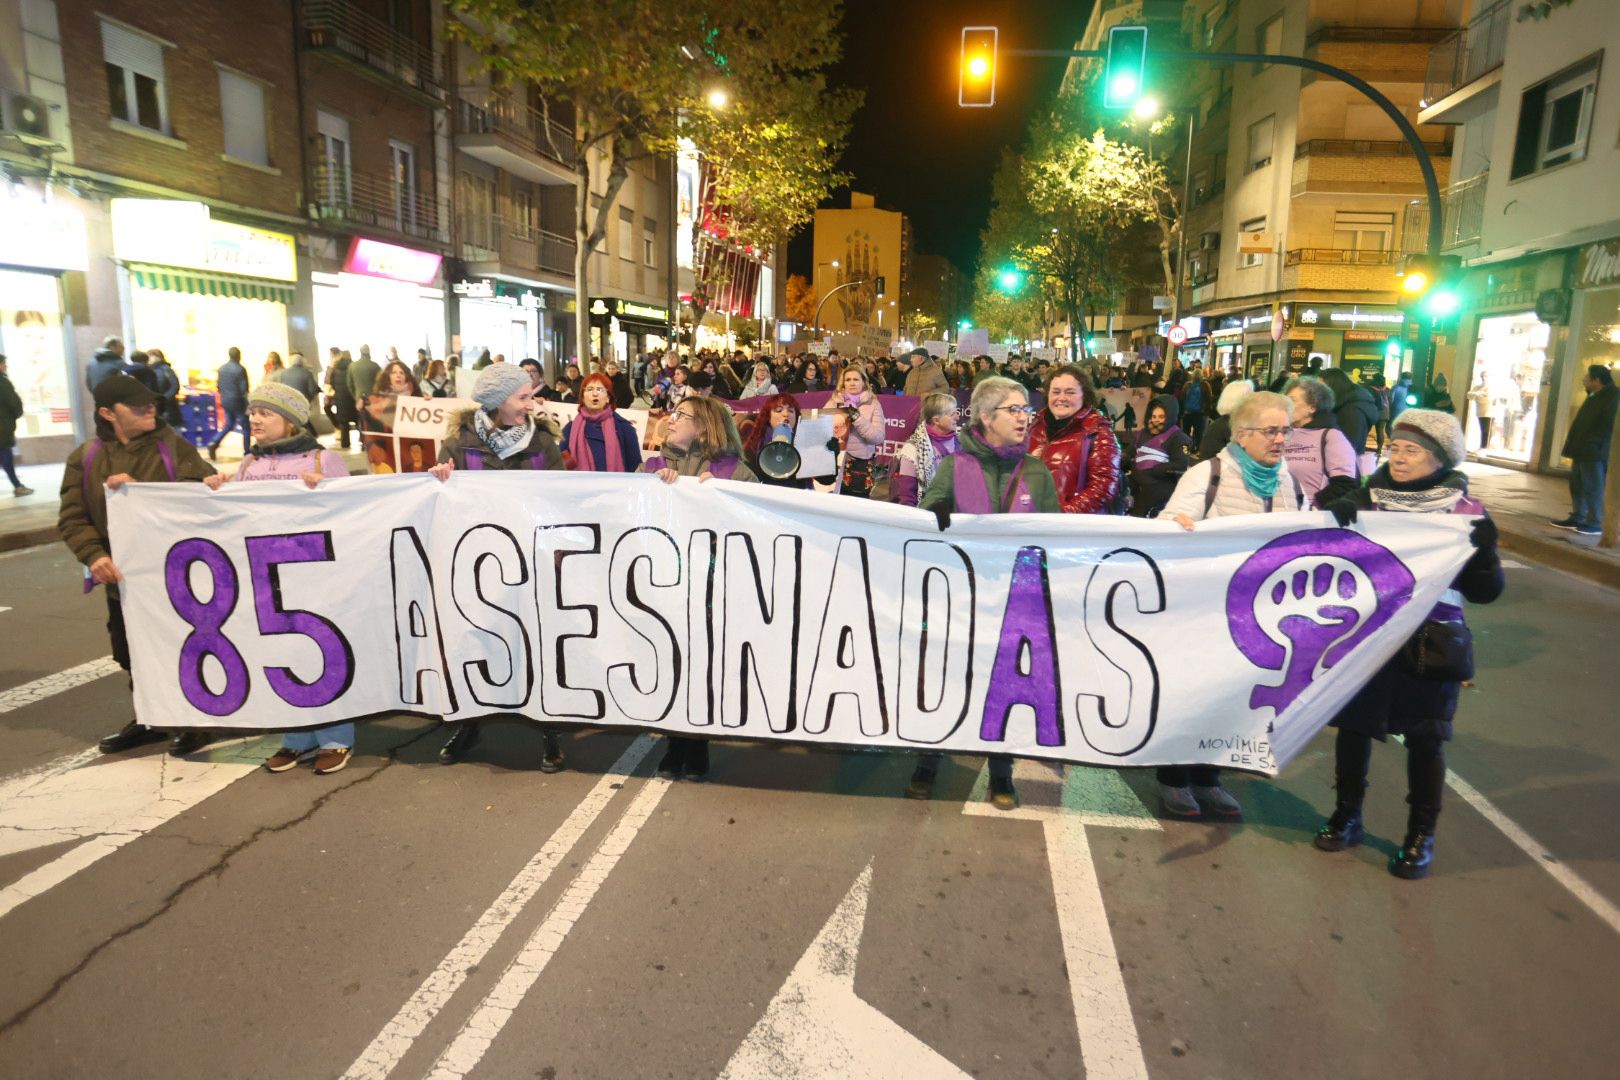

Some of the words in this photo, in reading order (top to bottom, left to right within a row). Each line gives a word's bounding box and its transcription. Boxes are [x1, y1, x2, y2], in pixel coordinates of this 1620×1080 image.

[400, 406, 444, 424] NOS
[164, 529, 356, 717] 85
[389, 522, 1167, 757] ASESINADAS
[1231, 753, 1252, 764] DE
[1259, 757, 1277, 769] S
